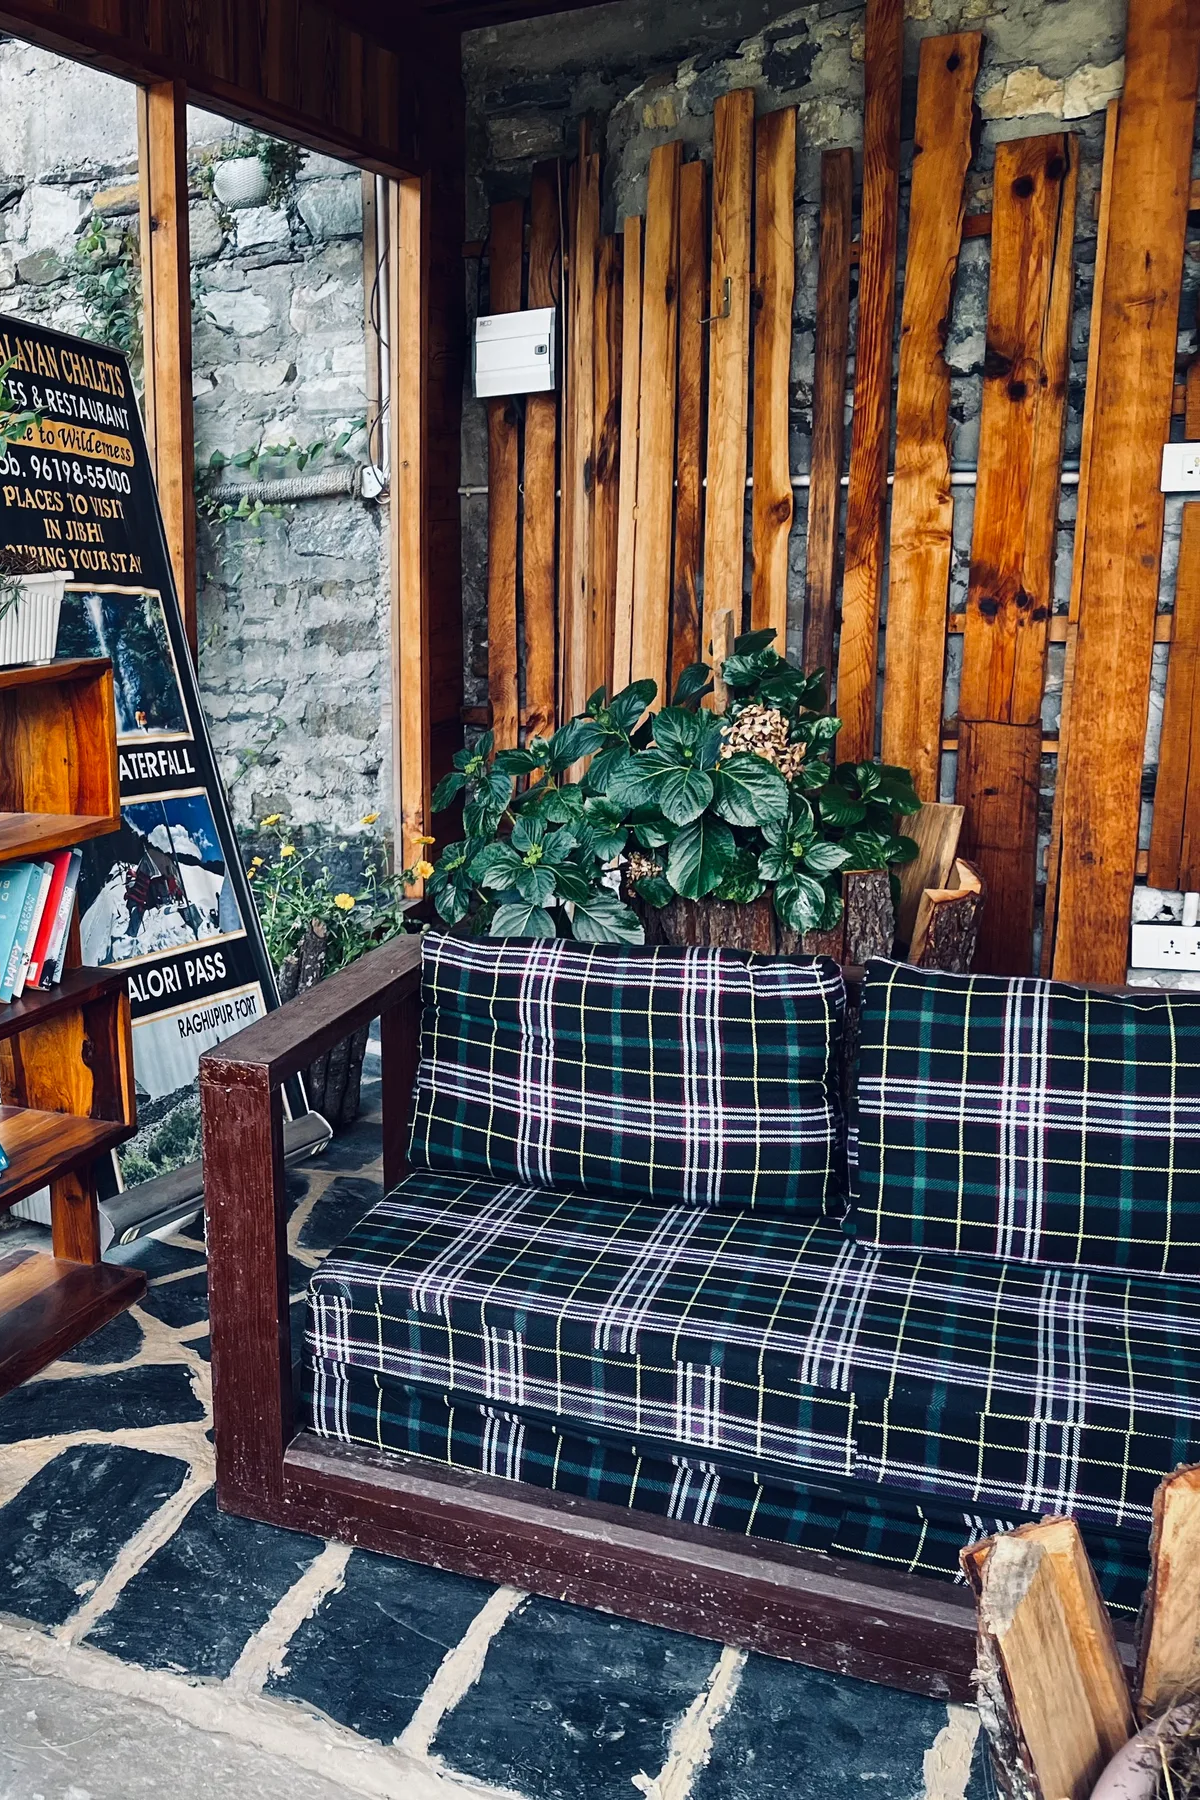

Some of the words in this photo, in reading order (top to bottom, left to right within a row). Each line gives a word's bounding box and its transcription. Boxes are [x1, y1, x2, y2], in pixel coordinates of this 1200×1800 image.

[61, 349, 126, 399] CHALETS
[32, 387, 44, 409] &
[45, 389, 131, 431] RESTAURANT
[39, 426, 55, 445] to
[57, 428, 132, 462] Wilderness
[30, 454, 131, 495] 96198-55000
[2, 484, 64, 513] PLACES
[66, 492, 88, 515] TO
[88, 495, 125, 520] VISIT
[43, 518, 61, 540] IN
[65, 520, 104, 544] JIBHI
[119, 748, 196, 782] ATERFALL
[18, 893, 31, 932] DERREN
[22, 896, 36, 932] BROWN
[3, 939, 22, 988] HAPPY
[128, 964, 182, 1003] ALORI
[184, 952, 227, 987] PASS
[177, 1003, 235, 1039] RAGHUPUR
[235, 995, 258, 1020] FORT
